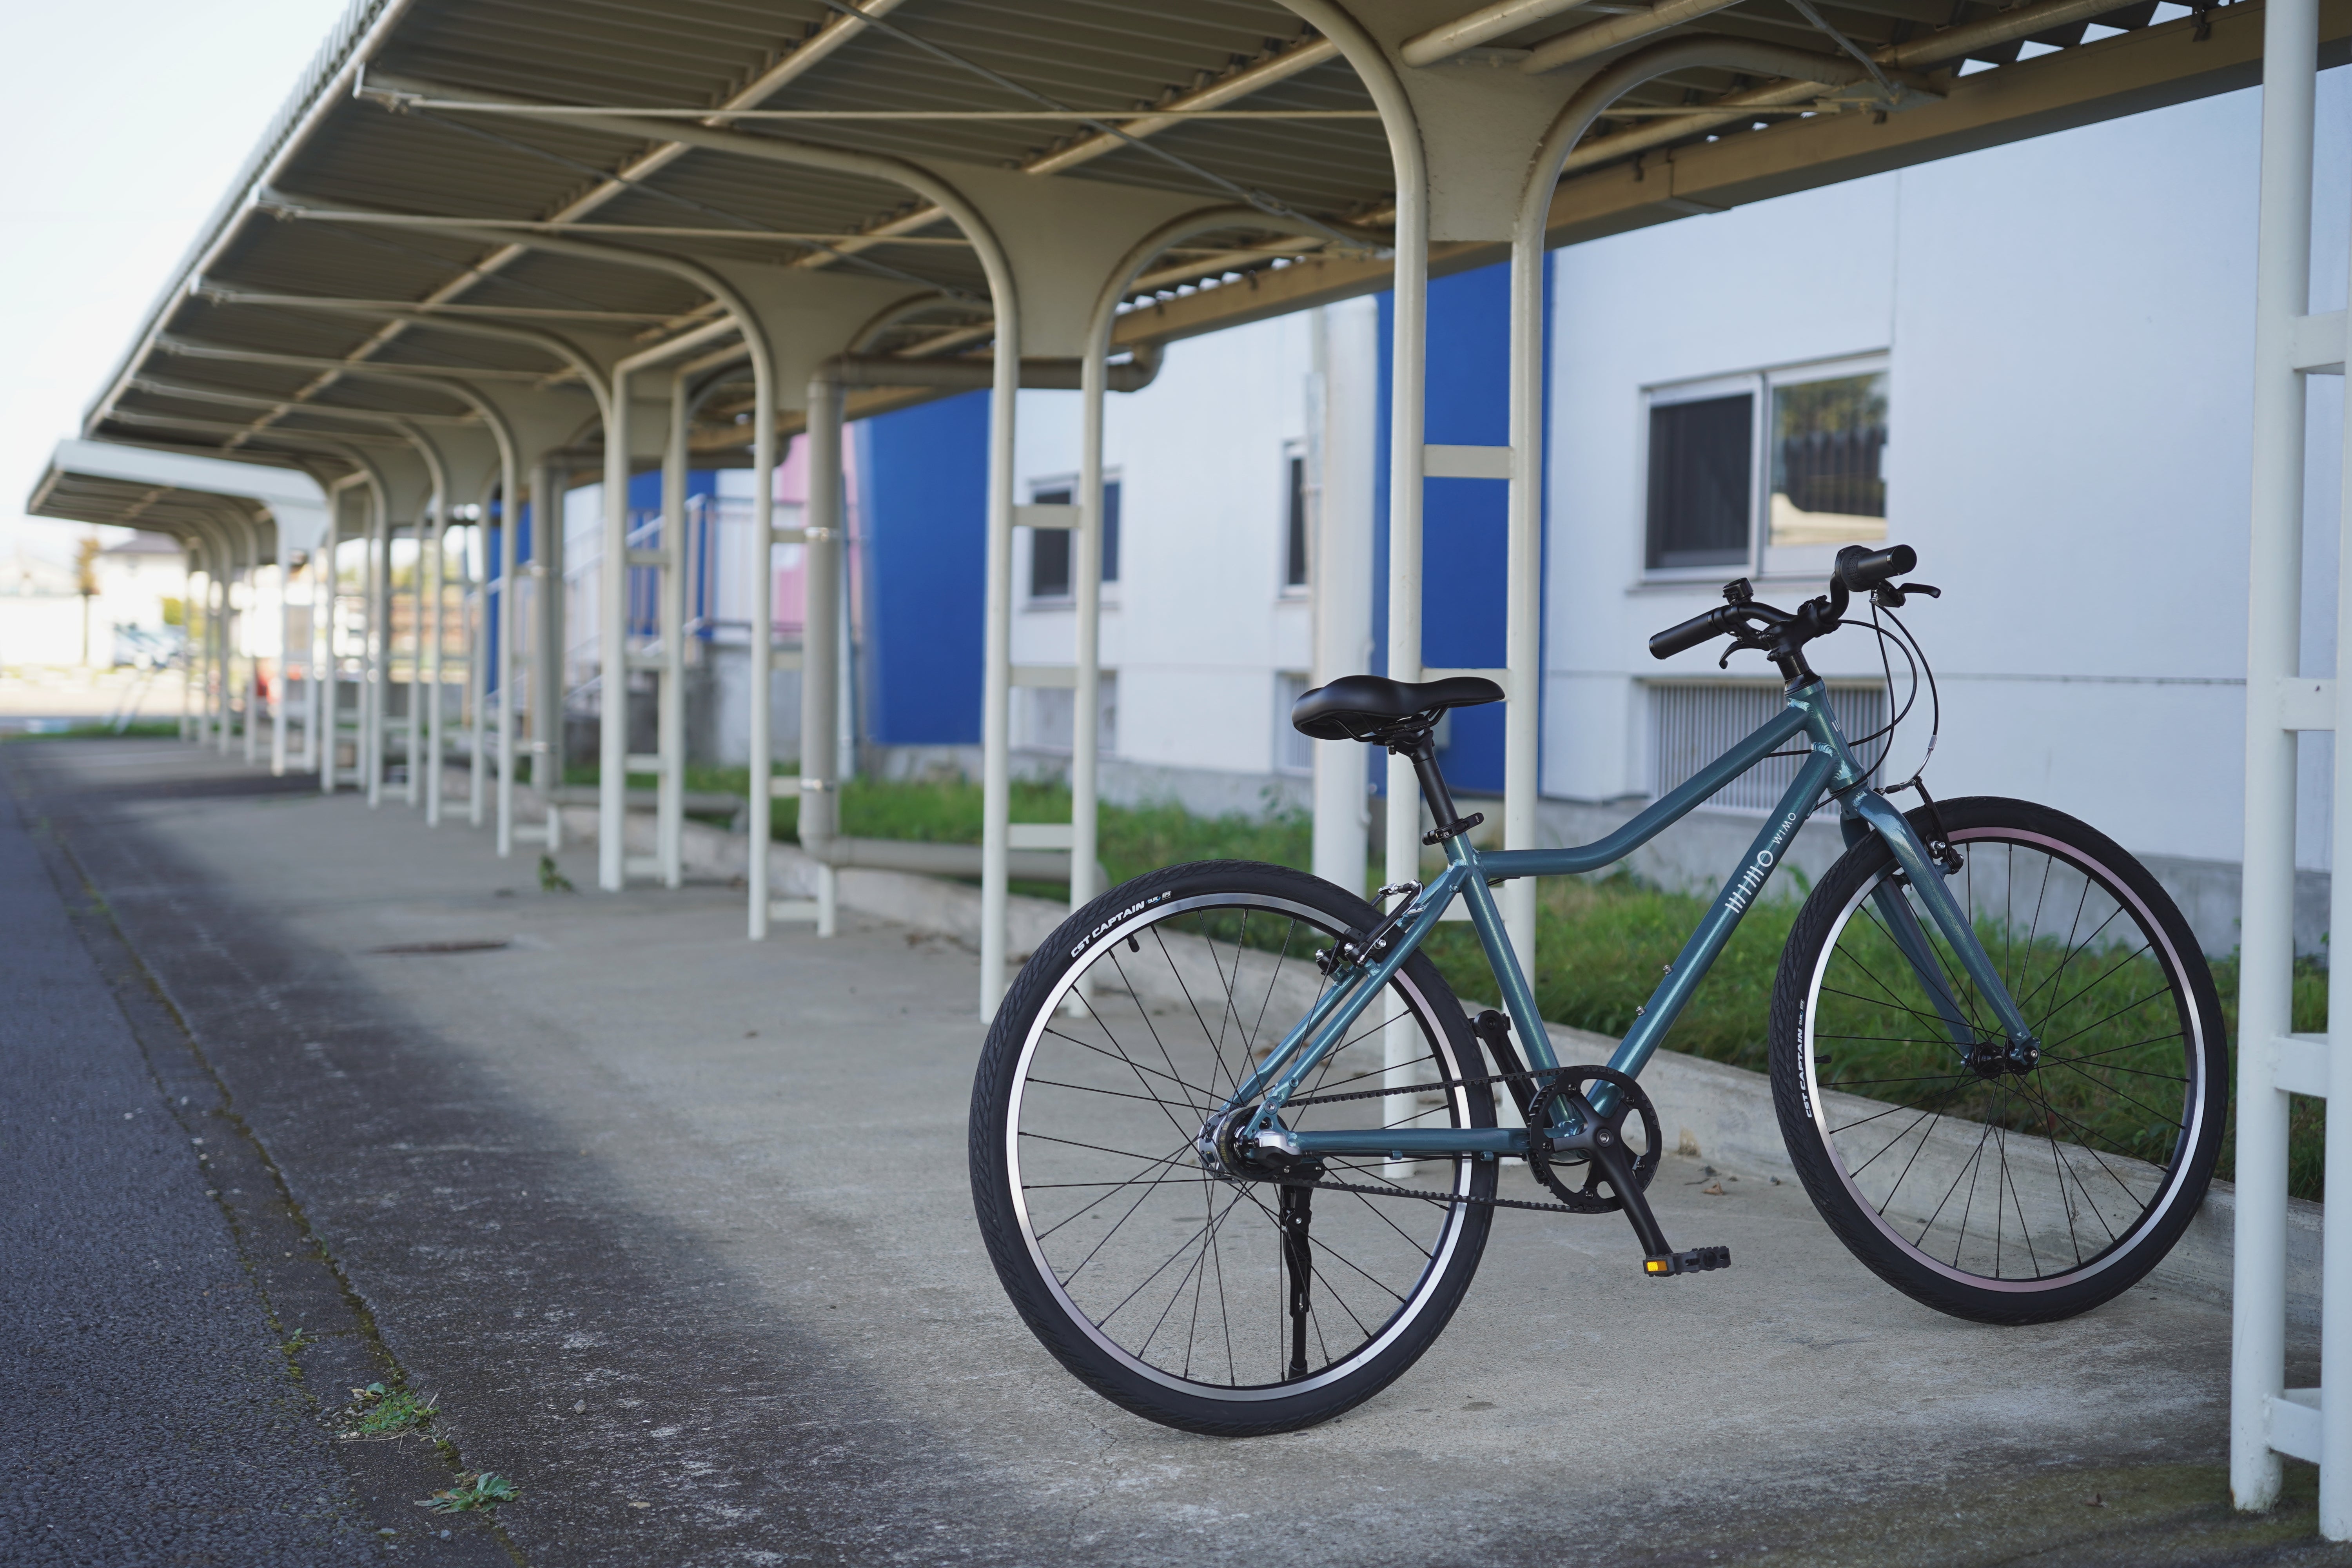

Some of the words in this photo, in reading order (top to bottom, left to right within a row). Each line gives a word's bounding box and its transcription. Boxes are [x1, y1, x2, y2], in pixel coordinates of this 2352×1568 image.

[1771, 812, 1796, 844] WIMO
[1071, 935, 1090, 958] CST
[1092, 901, 1145, 938] CAPTAIN
[1797, 1028, 1806, 1090] CAPTAIN
[1802, 1093, 1812, 1118] CST
